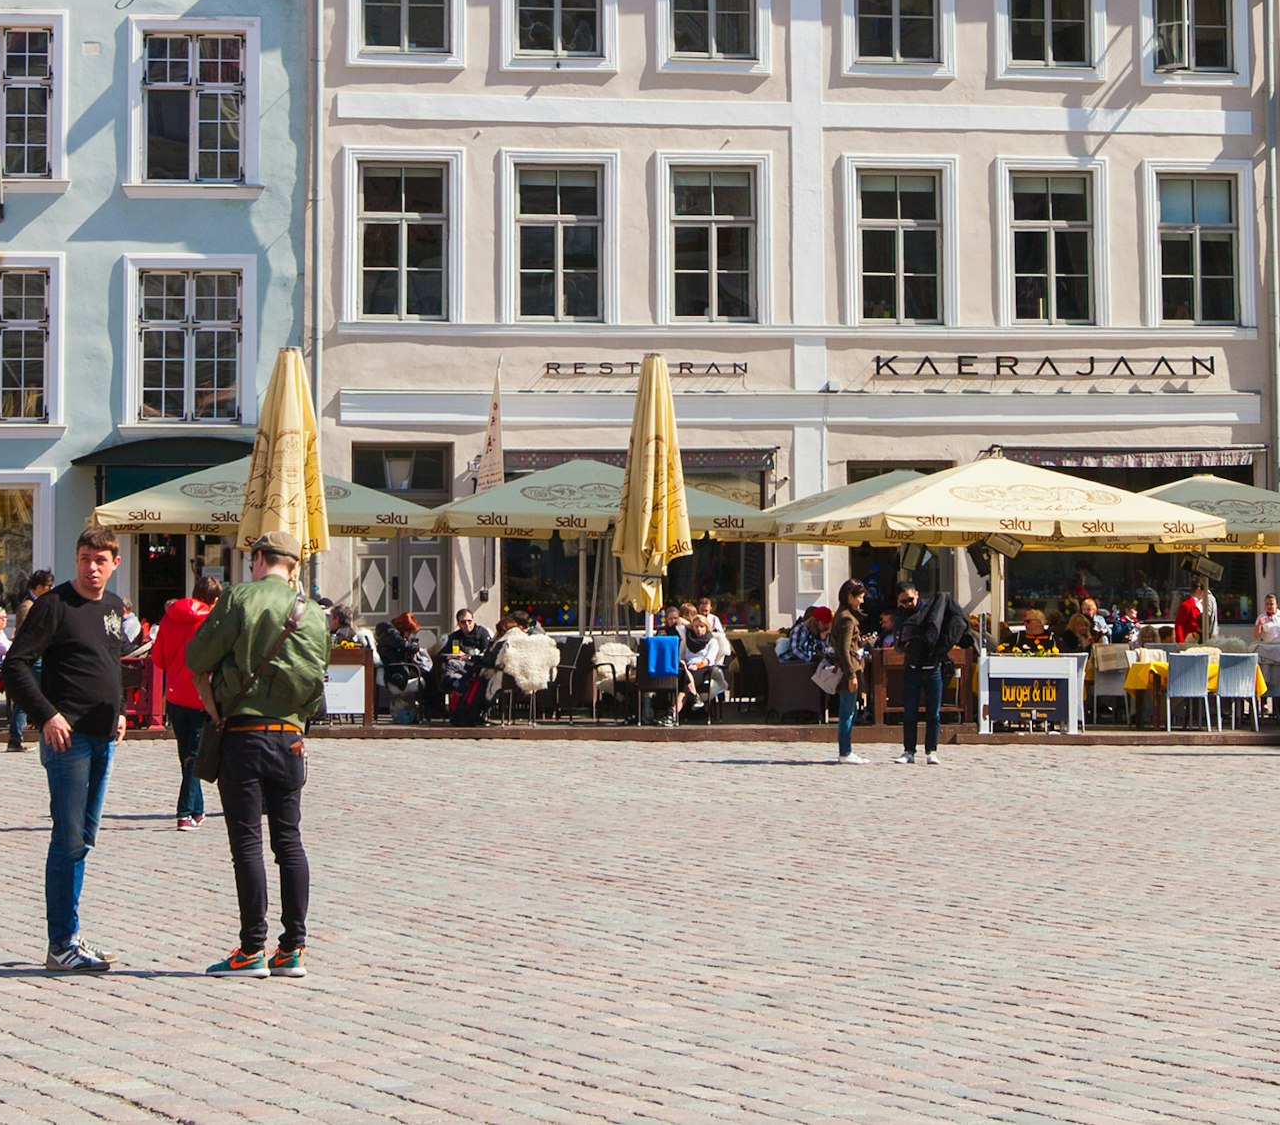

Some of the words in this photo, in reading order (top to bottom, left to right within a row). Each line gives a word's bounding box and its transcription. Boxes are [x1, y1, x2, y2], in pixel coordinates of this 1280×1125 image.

[546, 362, 748, 375] RESTRAN
[875, 355, 1215, 376] KAERAJAAN
[128, 509, 161, 521] saku
[376, 512, 408, 525] saku
[476, 512, 508, 526] saku
[555, 514, 587, 528] saku
[713, 515, 745, 529] saku
[916, 514, 950, 527] saku
[999, 517, 1032, 531] saku
[1082, 519, 1115, 533] saku
[1163, 520, 1195, 534] saku
[1002, 679, 1032, 708] burger
[1032, 679, 1041, 702] &
